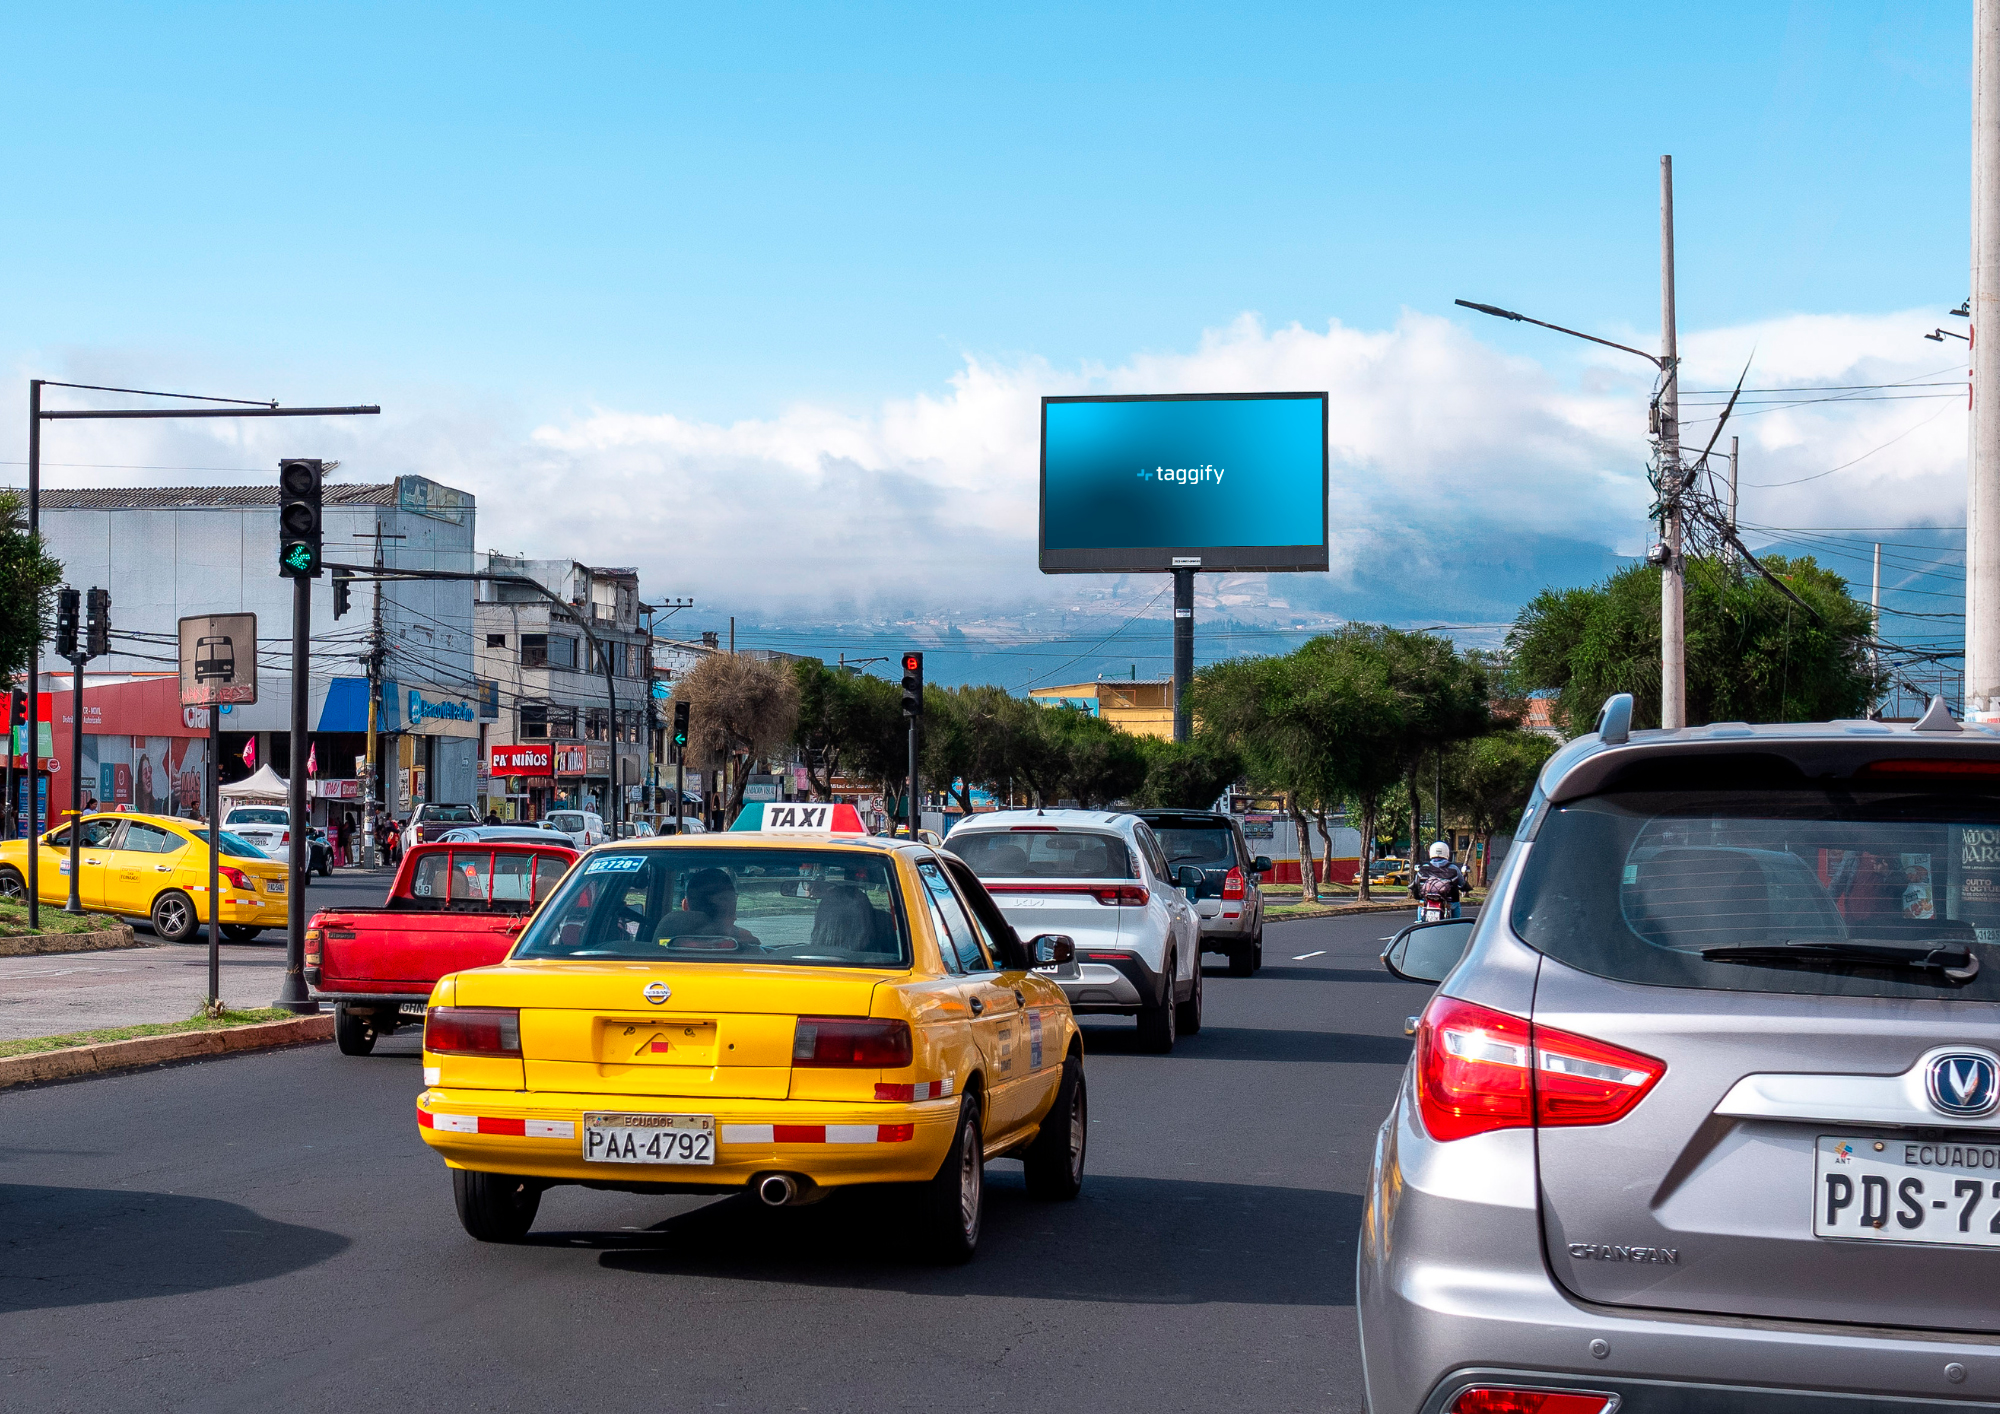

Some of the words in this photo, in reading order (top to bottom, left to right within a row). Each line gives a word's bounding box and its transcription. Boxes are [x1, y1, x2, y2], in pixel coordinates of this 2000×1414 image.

[1156, 464, 1225, 485] taggify
[512, 750, 547, 766] NIÑOS
[567, 747, 583, 771] NIÑOS
[770, 807, 827, 828] TAXI
[1965, 878, 1992, 886] QUITO
[624, 1116, 674, 1128] ECUADOR
[588, 1130, 711, 1161] PAA-4792
[1835, 1157, 1852, 1165] ANT
[1567, 1242, 1679, 1266] CHANGAN
